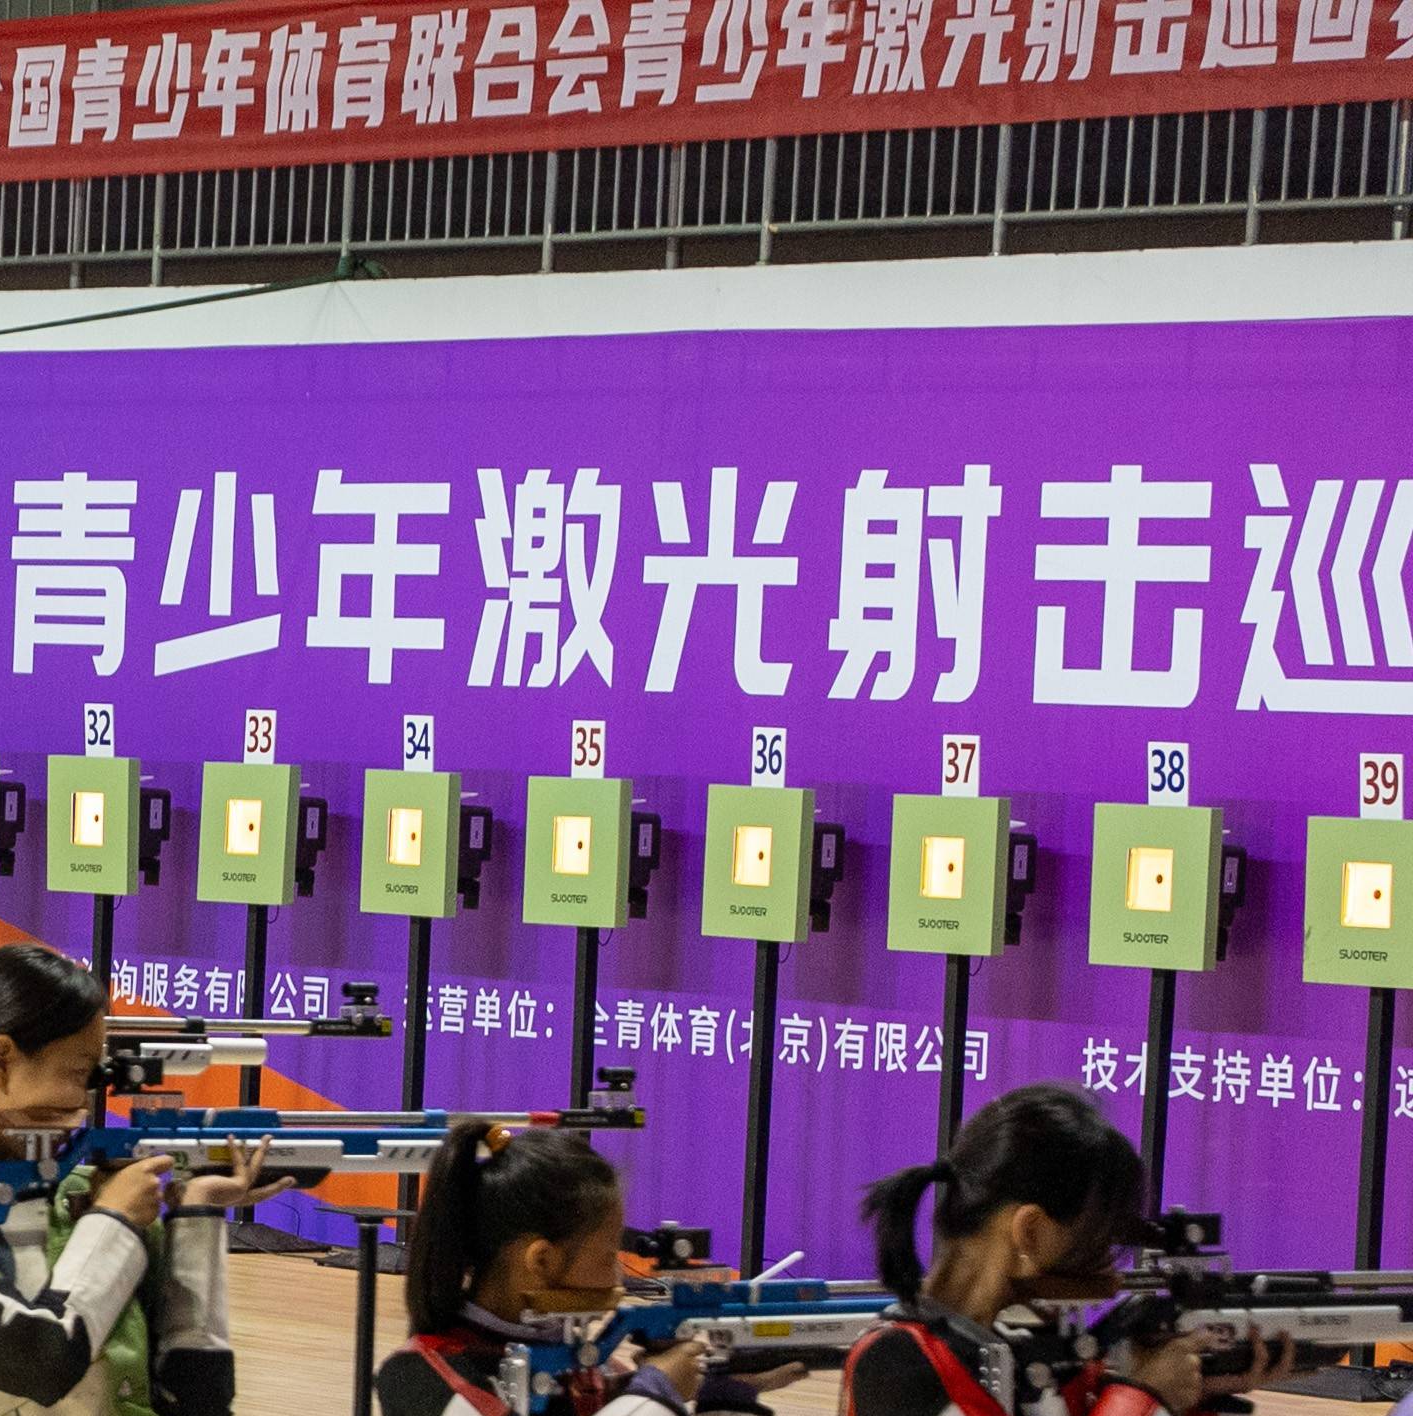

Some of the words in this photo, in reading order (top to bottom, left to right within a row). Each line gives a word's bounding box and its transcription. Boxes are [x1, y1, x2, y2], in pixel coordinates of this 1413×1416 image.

[88, 710, 111, 745] 32
[247, 716, 272, 753] 33
[407, 722, 430, 760] 34
[575, 727, 601, 766] 35
[755, 734, 782, 775] 36
[945, 742, 976, 783] 37
[1151, 749, 1184, 793] 38
[1364, 761, 1398, 805] 39
